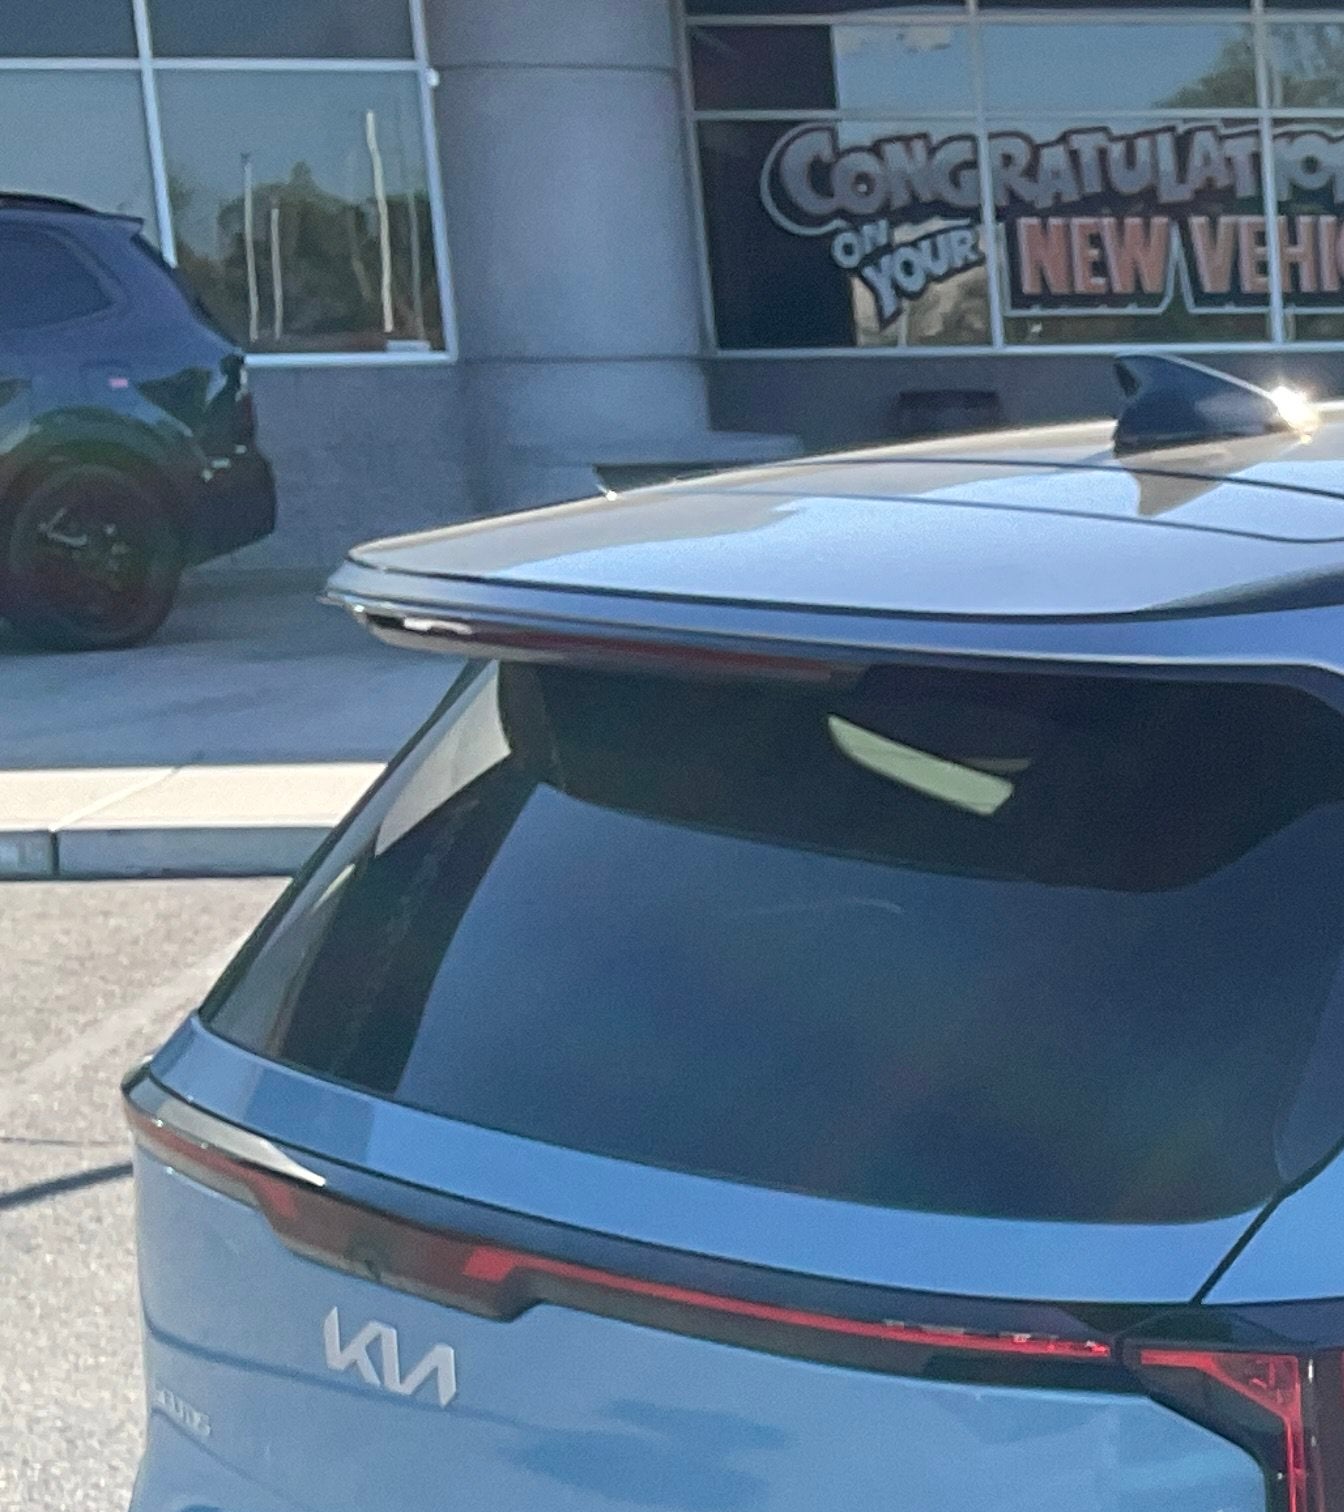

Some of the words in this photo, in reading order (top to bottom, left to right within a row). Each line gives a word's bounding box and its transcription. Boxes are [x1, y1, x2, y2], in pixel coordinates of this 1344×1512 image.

[831, 219, 889, 269] ON
[861, 229, 980, 320] YOUR
[1016, 215, 1168, 294] NEW
[323, 1306, 456, 1407] KIA
